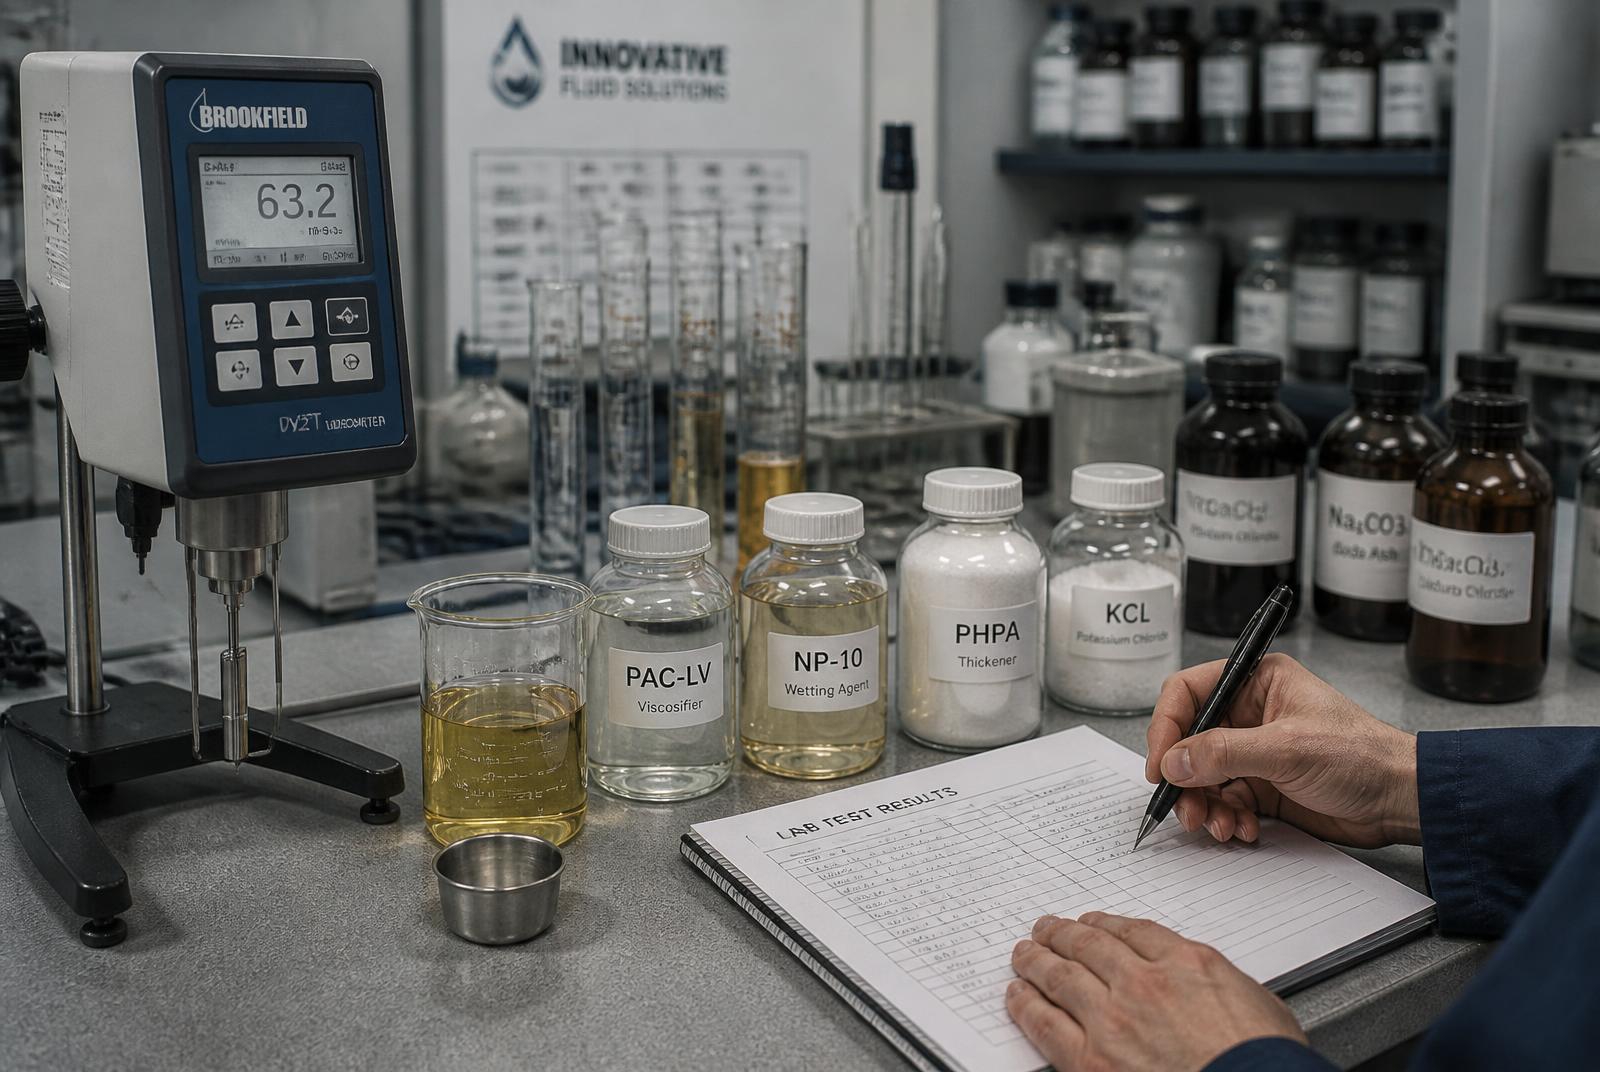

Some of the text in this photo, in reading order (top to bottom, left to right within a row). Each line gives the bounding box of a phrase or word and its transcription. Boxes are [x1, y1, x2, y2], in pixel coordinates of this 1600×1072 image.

[561, 40, 727, 75] INNOVATIVE
[561, 75, 727, 100] FLUID SOLUTIONS
[200, 105, 307, 128] BROOKFIELD
[257, 183, 337, 219] 63.2
[1106, 603, 1150, 623] KCL
[955, 621, 1020, 644] PHPA
[794, 648, 863, 672] NP-10
[958, 655, 1017, 668] Thickener
[626, 661, 711, 688] PAC-LV
[785, 680, 870, 698] Wetting Agent
[638, 699, 704, 713] Viscosifier
[776, 787, 959, 841] LAB TEST RESULTS
